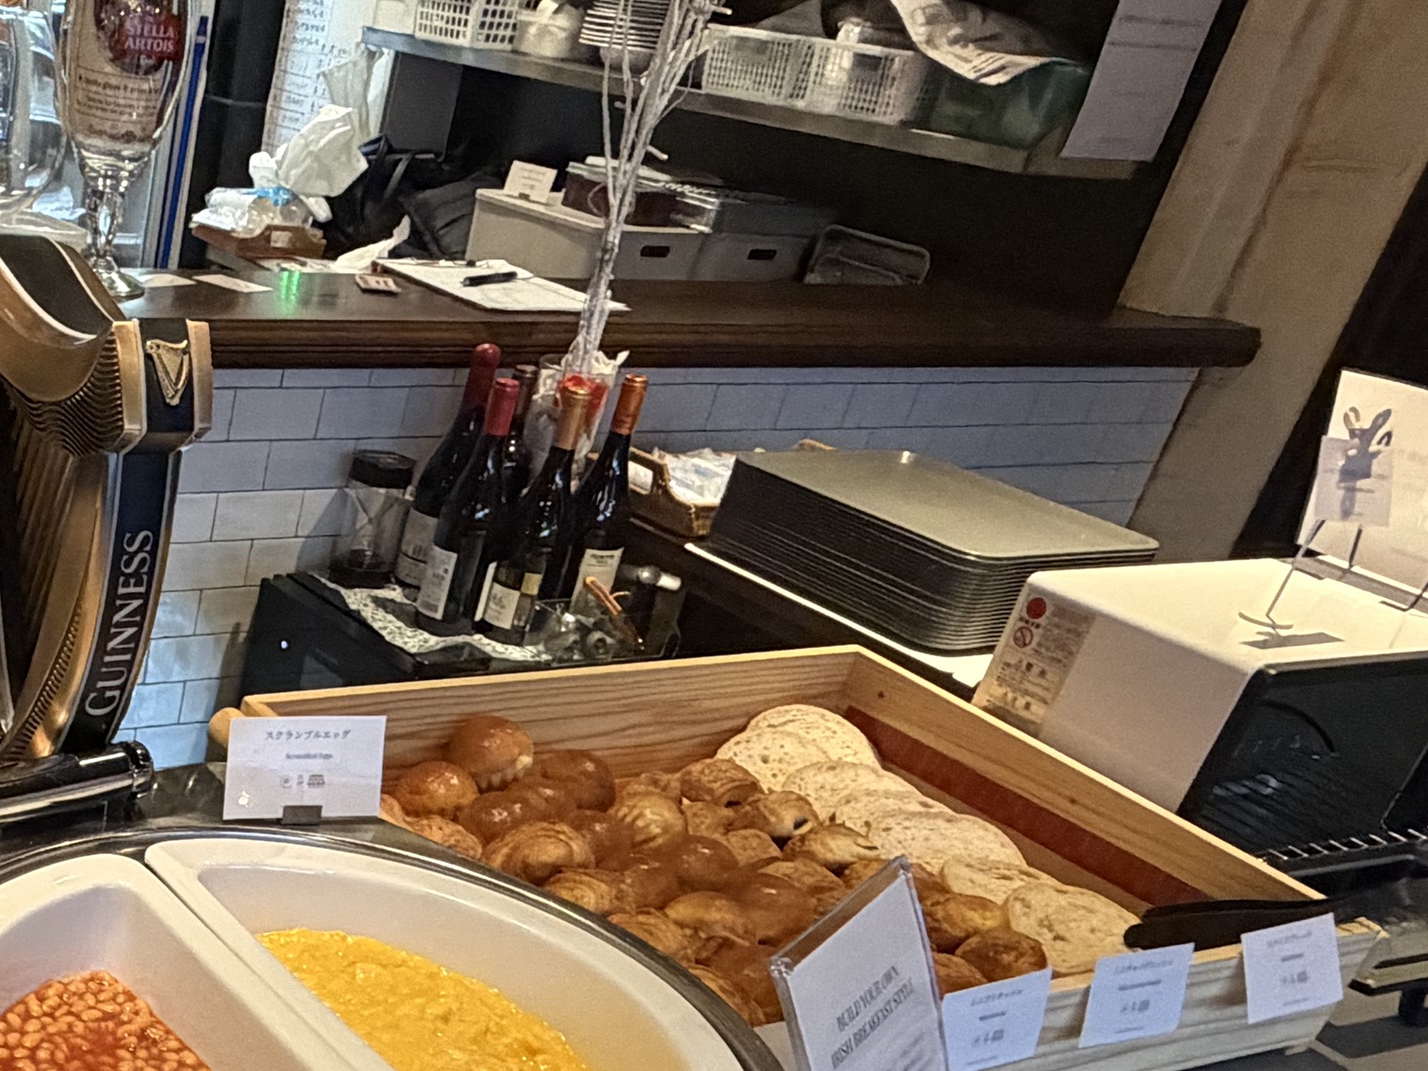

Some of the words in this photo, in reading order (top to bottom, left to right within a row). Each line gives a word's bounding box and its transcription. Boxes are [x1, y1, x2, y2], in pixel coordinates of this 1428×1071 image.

[125, 19, 176, 38] STELLA
[124, 37, 175, 52] ARTOIS
[85, 530, 153, 716] GUINNESS
